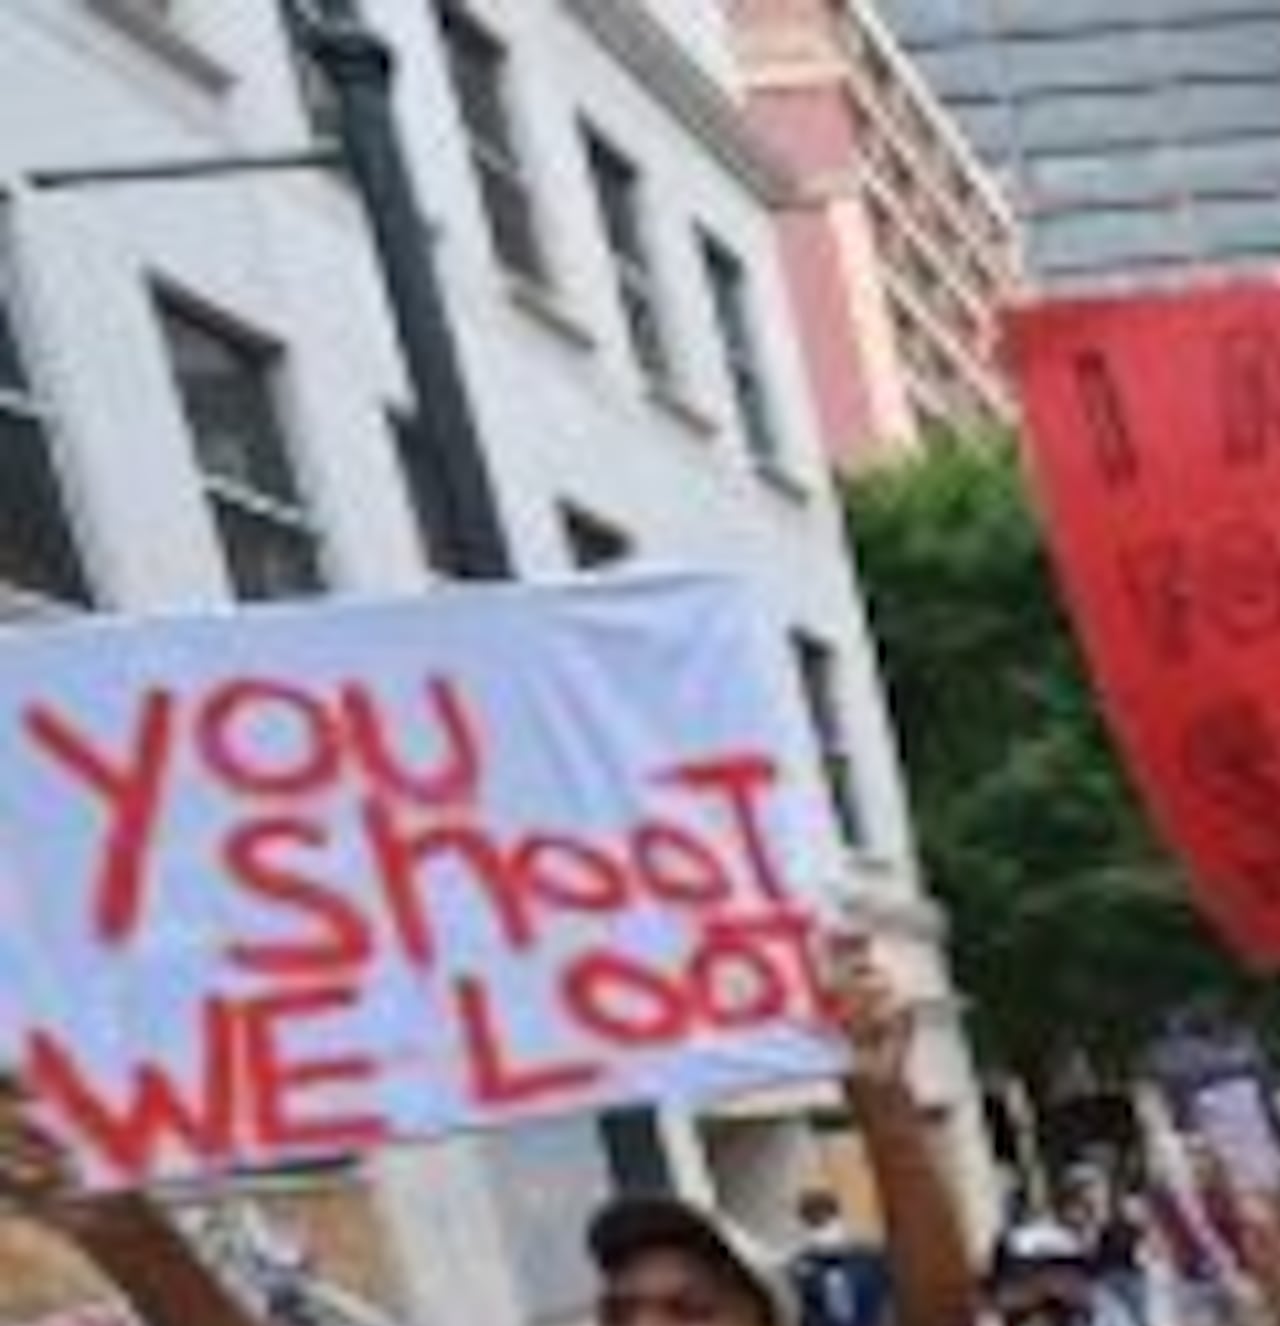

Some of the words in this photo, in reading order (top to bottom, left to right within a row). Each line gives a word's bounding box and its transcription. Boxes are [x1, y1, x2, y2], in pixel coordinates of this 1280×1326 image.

[1072, 346, 1138, 492] I
[22, 672, 482, 946] YOU
[22, 985, 388, 1178] WE
[457, 906, 852, 1108] LOOT
